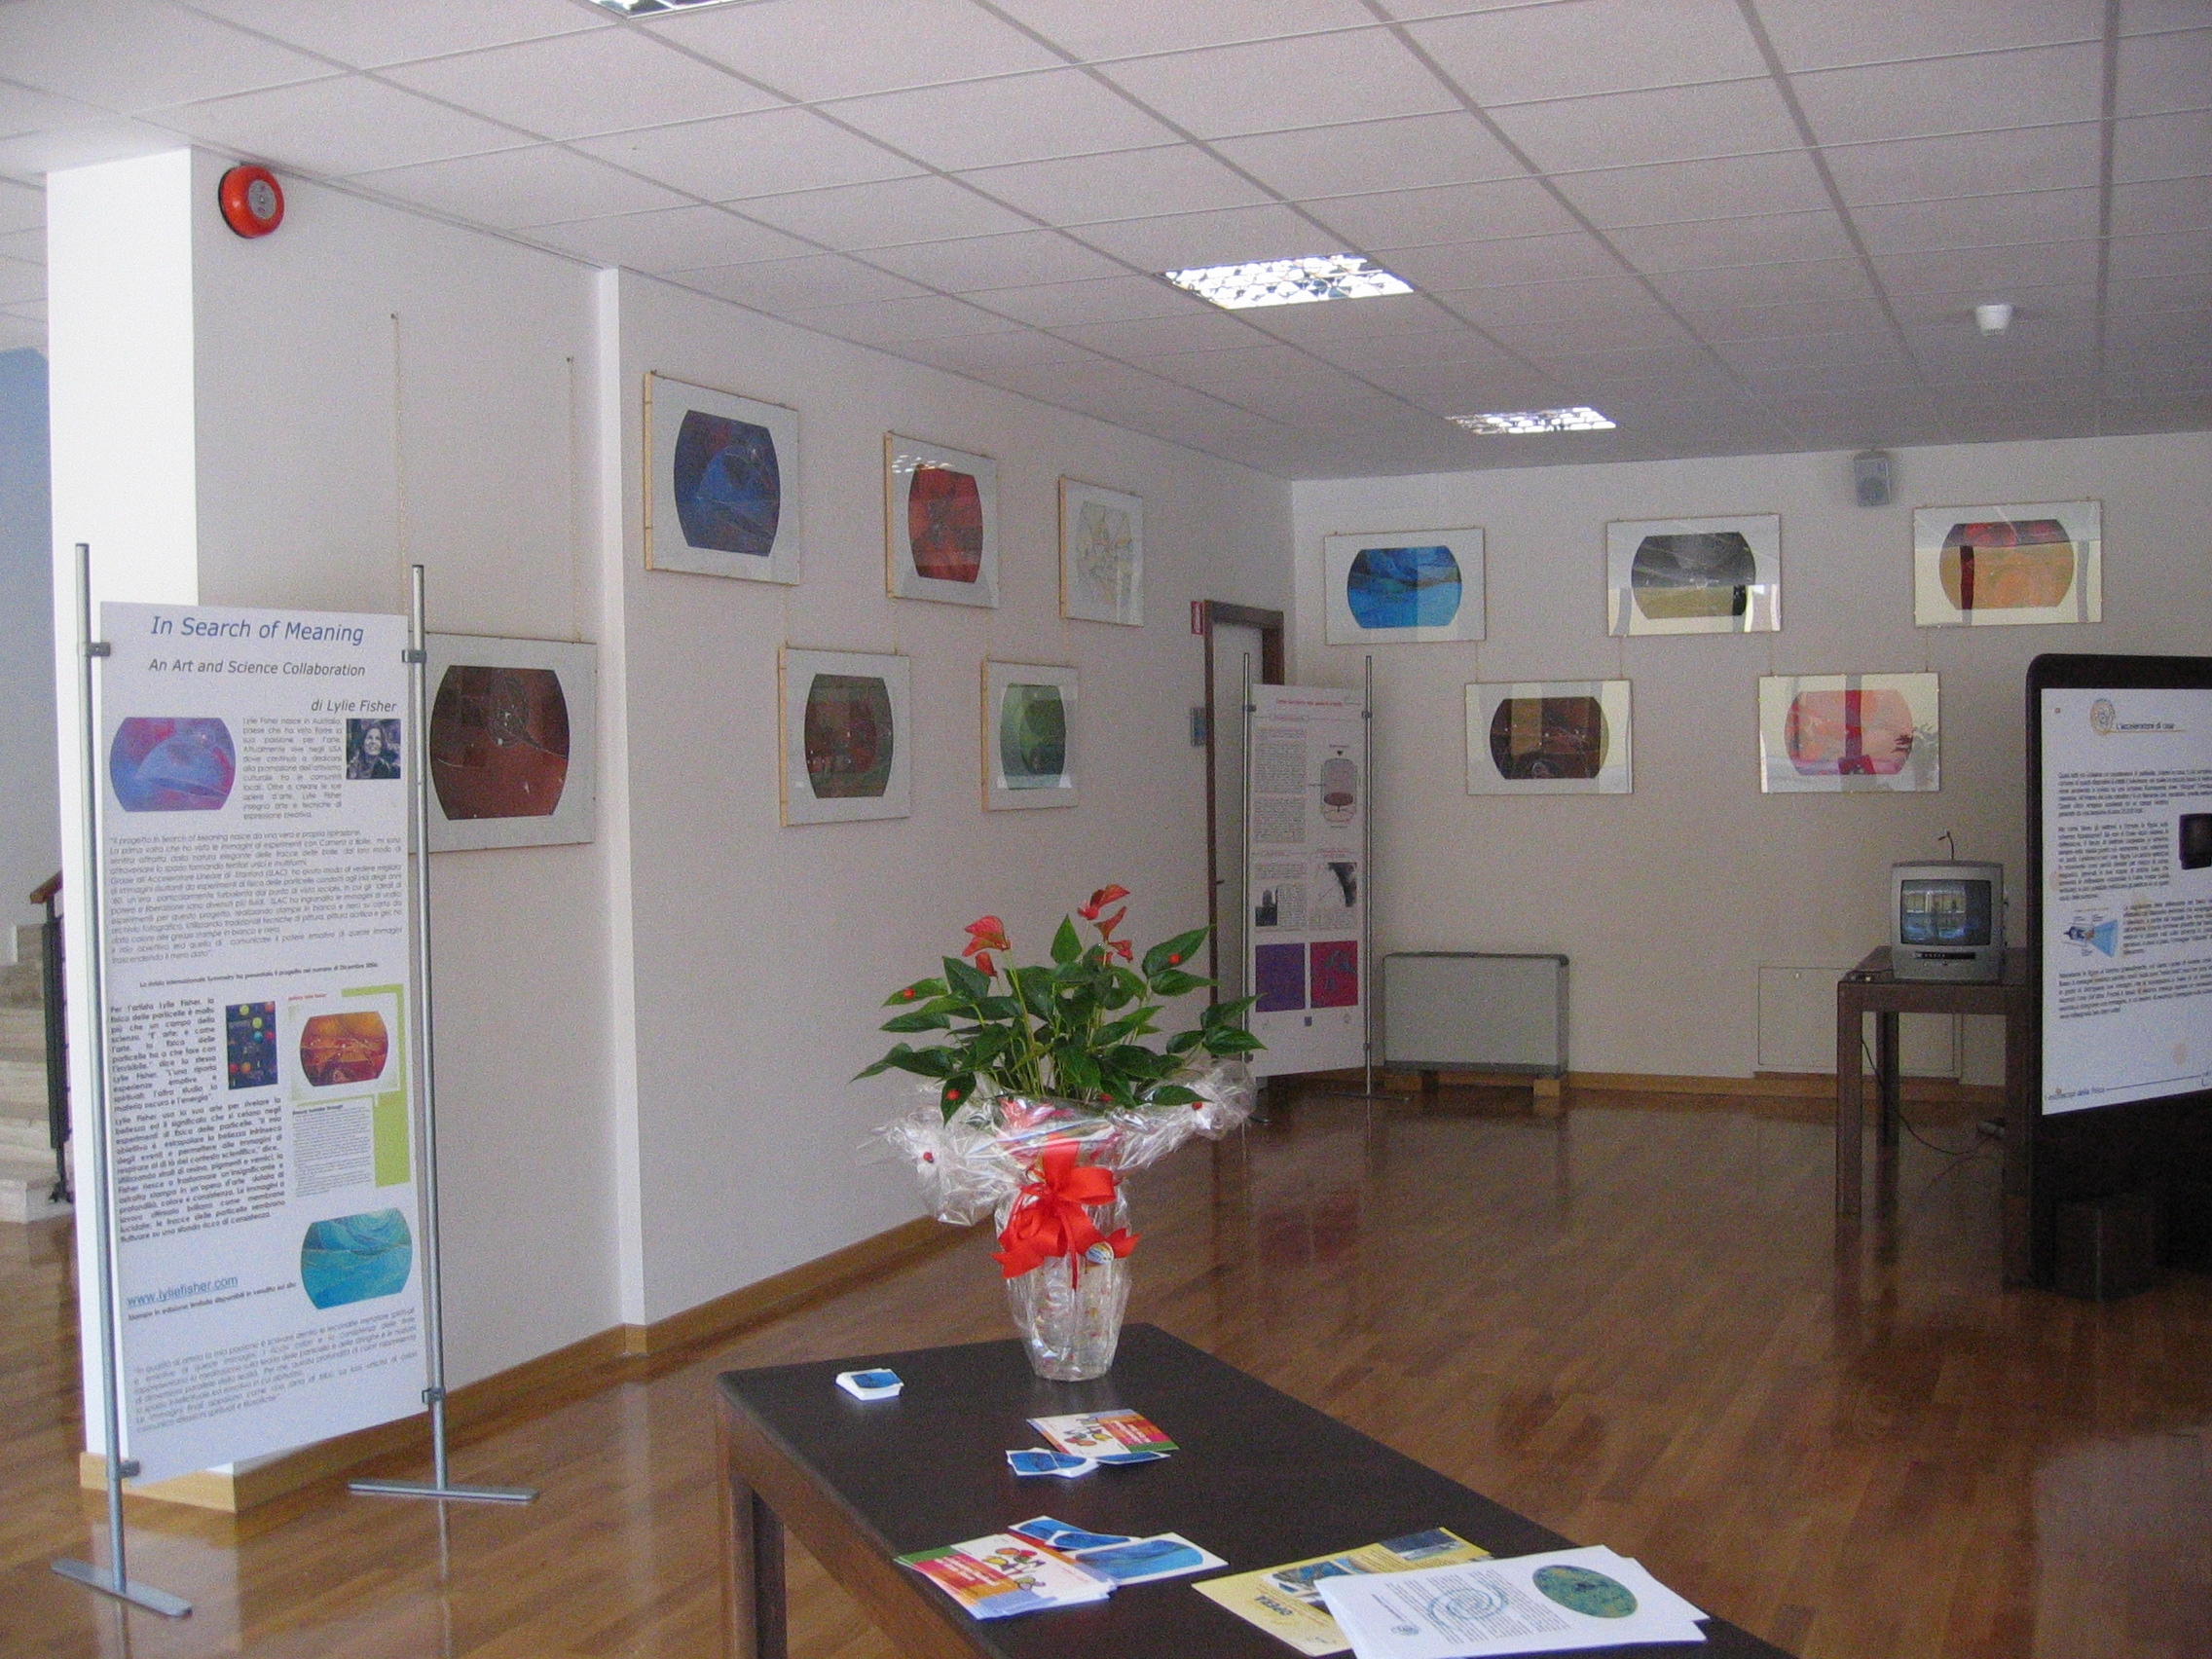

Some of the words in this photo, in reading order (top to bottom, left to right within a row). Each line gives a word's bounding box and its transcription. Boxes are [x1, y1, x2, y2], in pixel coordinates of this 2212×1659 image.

[150, 616, 173, 635] In
[181, 617, 251, 638] Search
[259, 621, 280, 639] of
[284, 622, 364, 646] Meaning
[148, 658, 167, 671] An
[171, 659, 194, 672] Art
[198, 659, 224, 673] and
[228, 660, 278, 674] Science
[283, 662, 366, 676] Collaboration
[311, 699, 322, 711] di
[327, 699, 355, 714] Lylie
[359, 700, 397, 712] Fisher
[127, 1276, 239, 1308] www.lyliefisher.com
